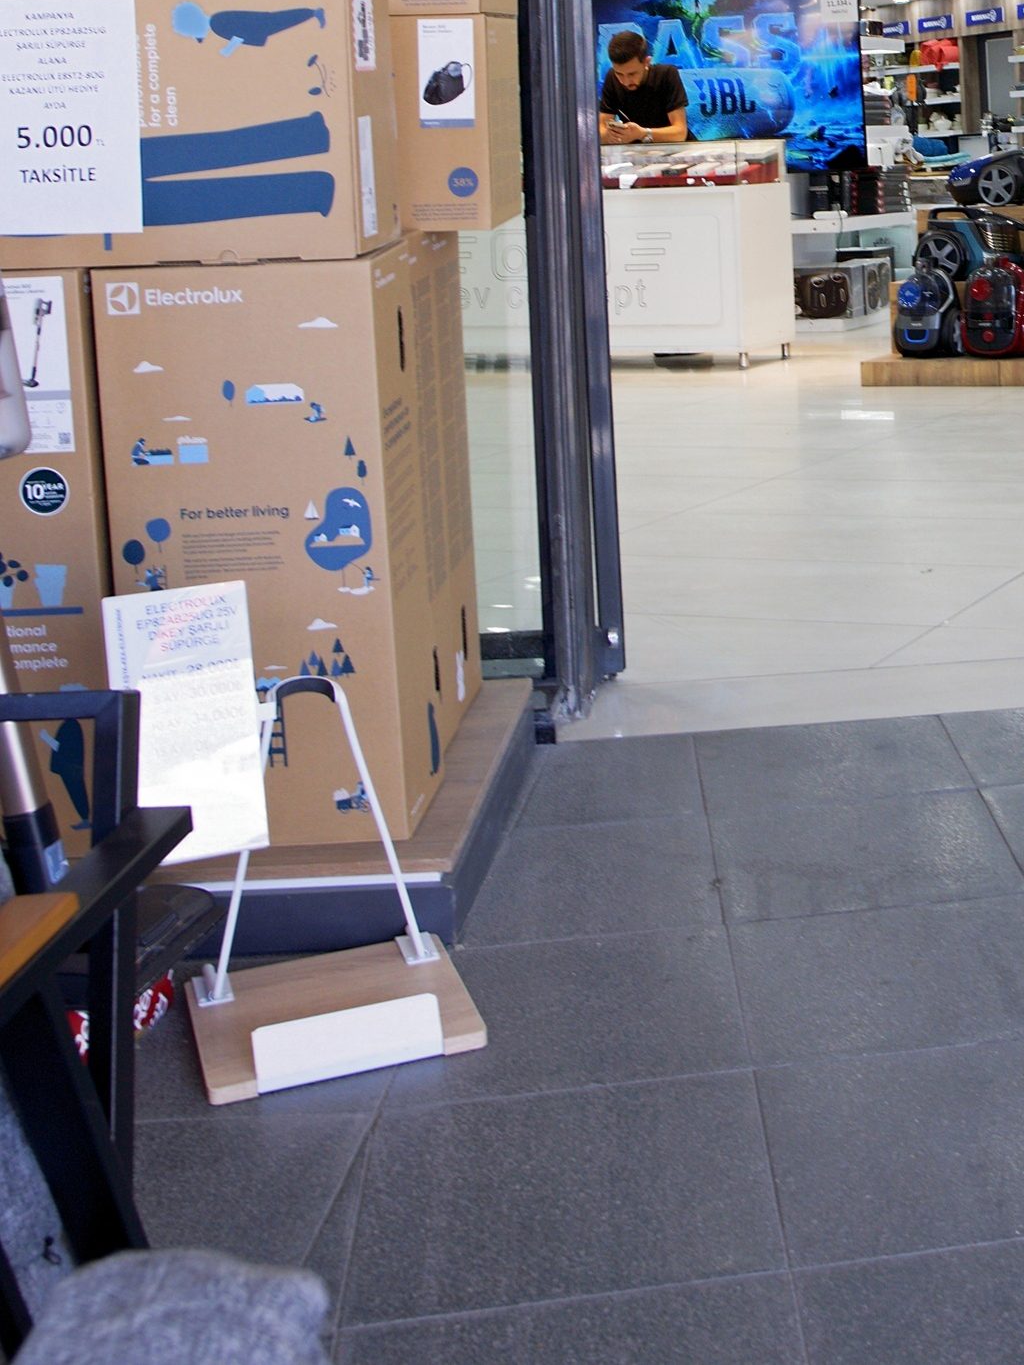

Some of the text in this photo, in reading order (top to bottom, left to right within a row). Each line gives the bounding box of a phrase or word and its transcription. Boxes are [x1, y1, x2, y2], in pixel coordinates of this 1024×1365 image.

[144, 23, 160, 91] complete
[165, 86, 178, 127] clean
[698, 77, 756, 118] JBL
[17, 124, 93, 149] 5.000
[20, 164, 97, 184] TAKSİTLE
[144, 286, 244, 307] Electrolux
[25, 483, 45, 500] 10
[179, 504, 290, 521] For better living
